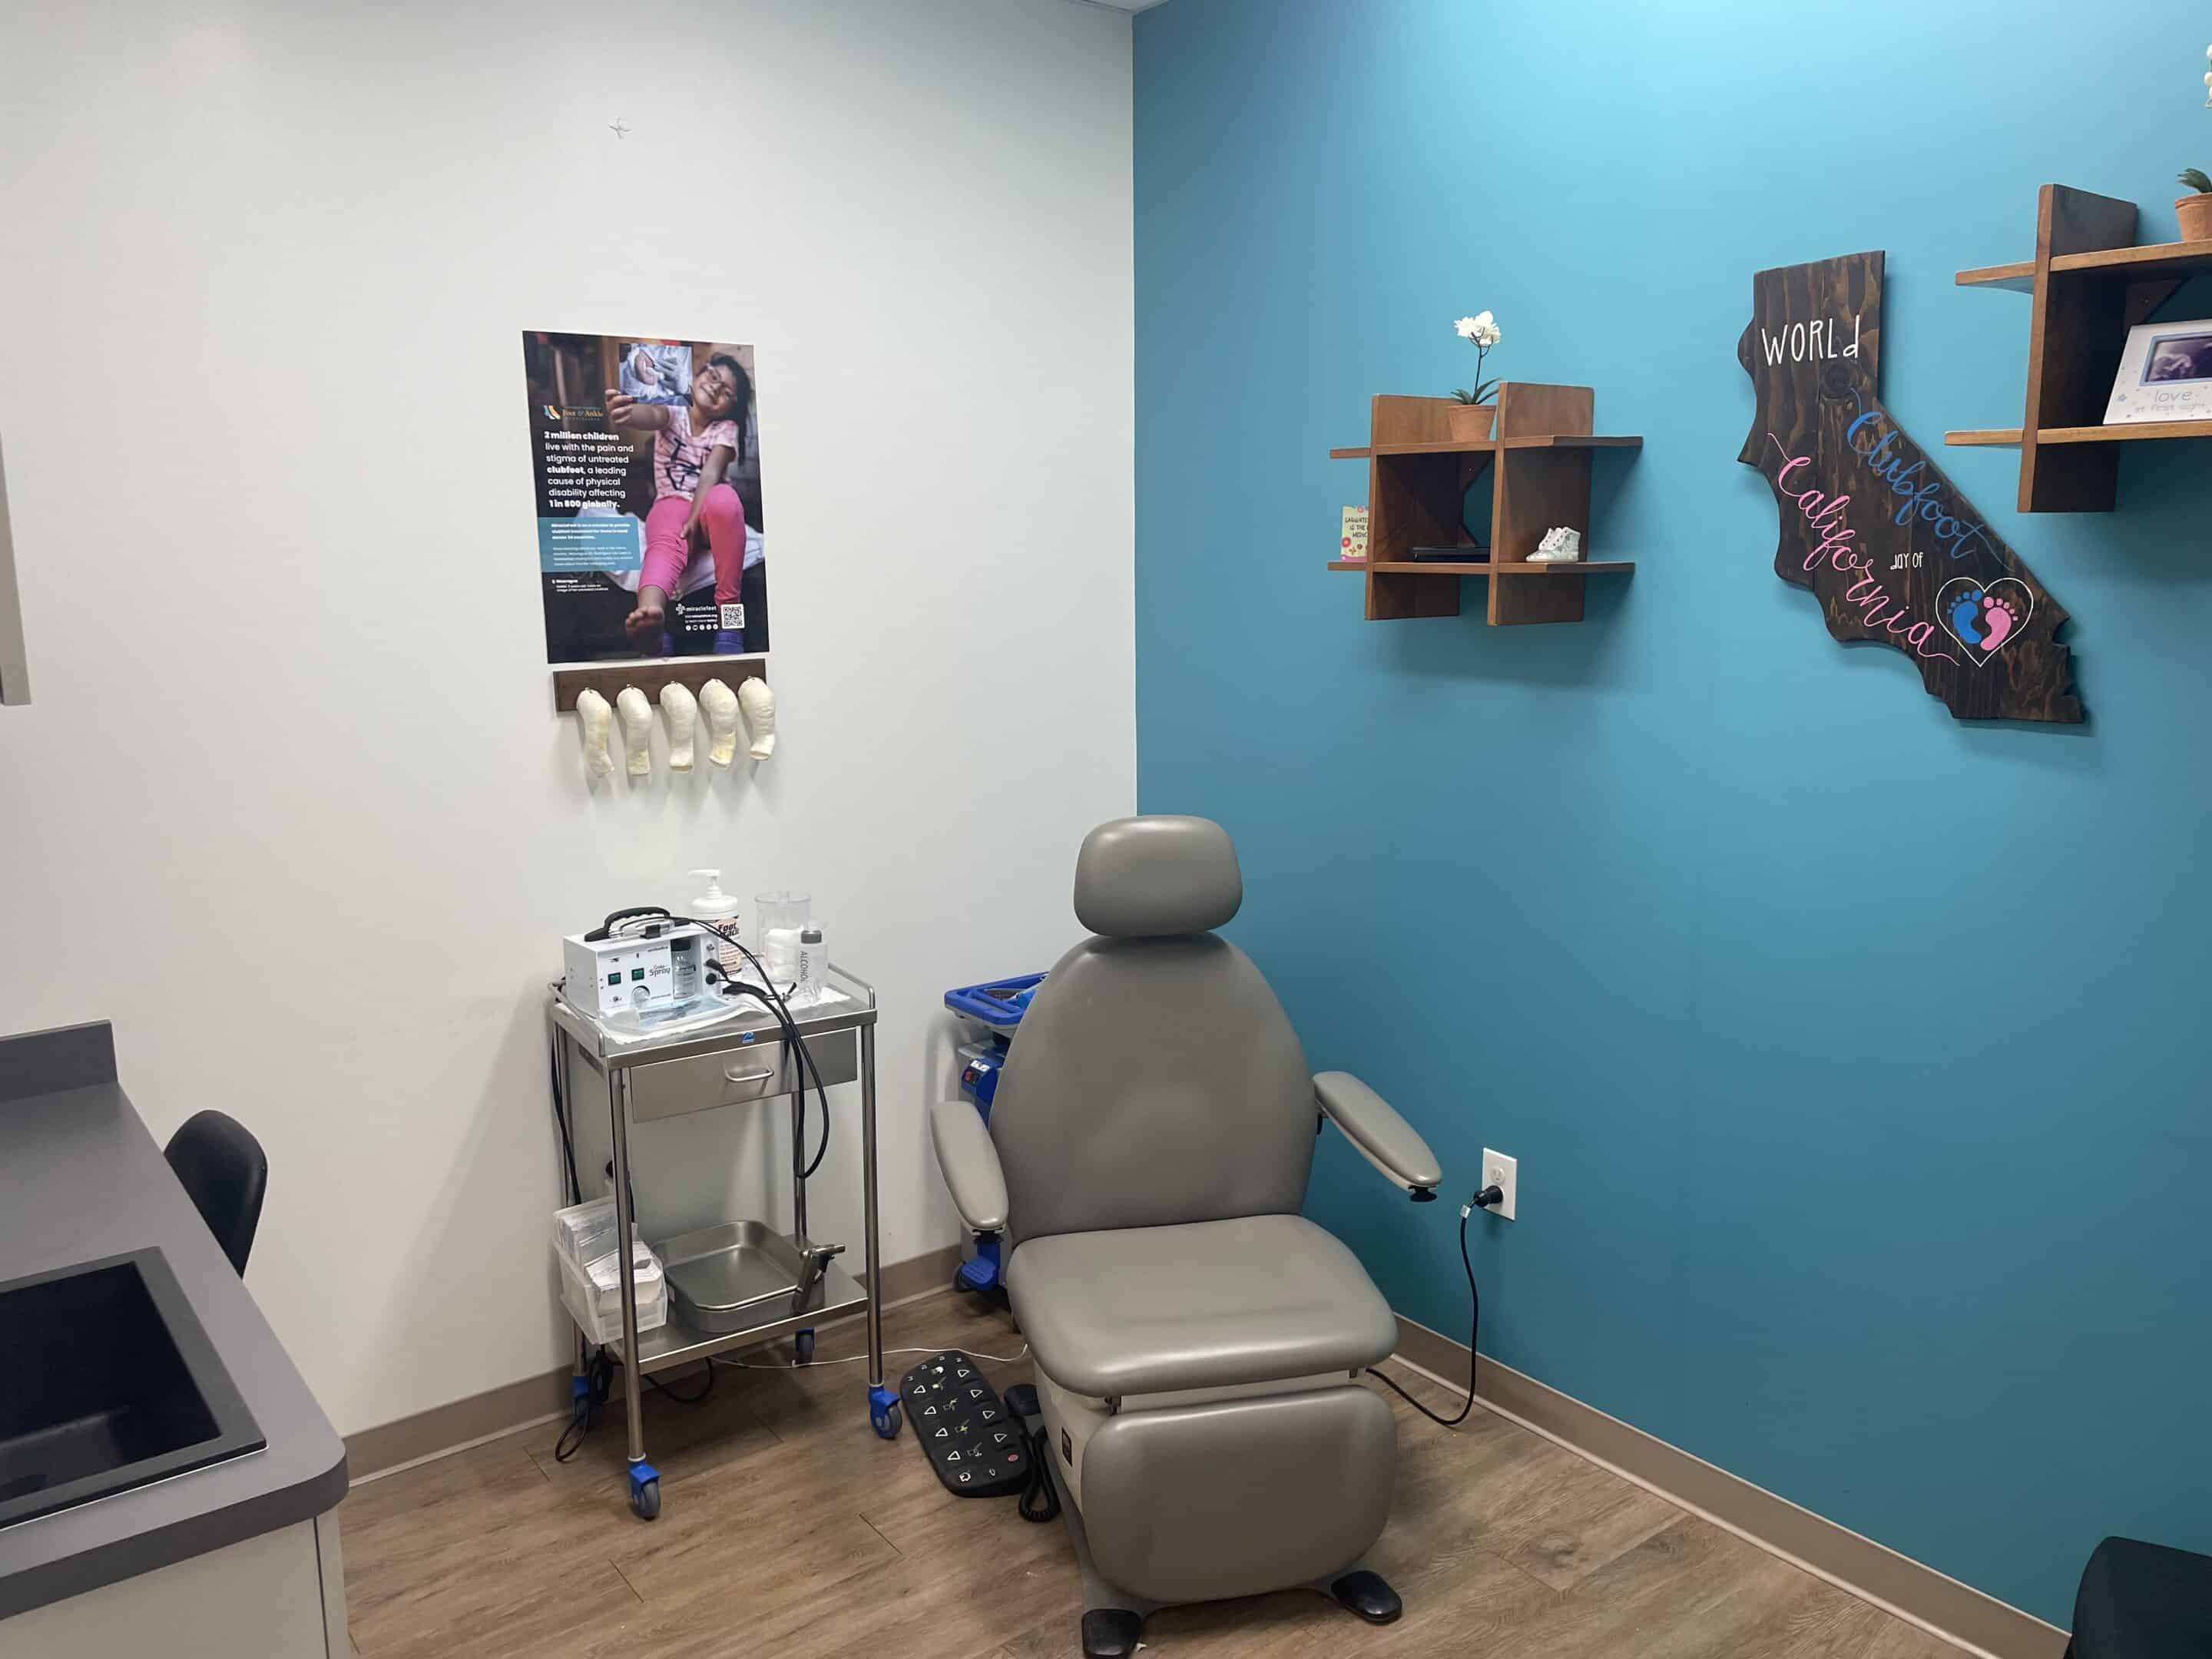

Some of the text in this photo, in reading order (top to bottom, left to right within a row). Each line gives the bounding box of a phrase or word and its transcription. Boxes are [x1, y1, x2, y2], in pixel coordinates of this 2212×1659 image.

[2154, 389, 2192, 402] love
[551, 430, 581, 439] million
[583, 432, 619, 441] children
[545, 442, 560, 451] live
[581, 443, 595, 452] the
[598, 444, 616, 454] pain
[546, 455, 576, 464] stigma
[595, 466, 626, 476] leading
[586, 478, 621, 487] physical
[1846, 387, 2015, 572] Clubfoot
[548, 488, 626, 498] disability affecting
[555, 499, 563, 508] in
[582, 500, 620, 510] globally.
[1767, 432, 1961, 667] California
[800, 950, 810, 983] ALCOHOL
[648, 968, 671, 977] Spray
